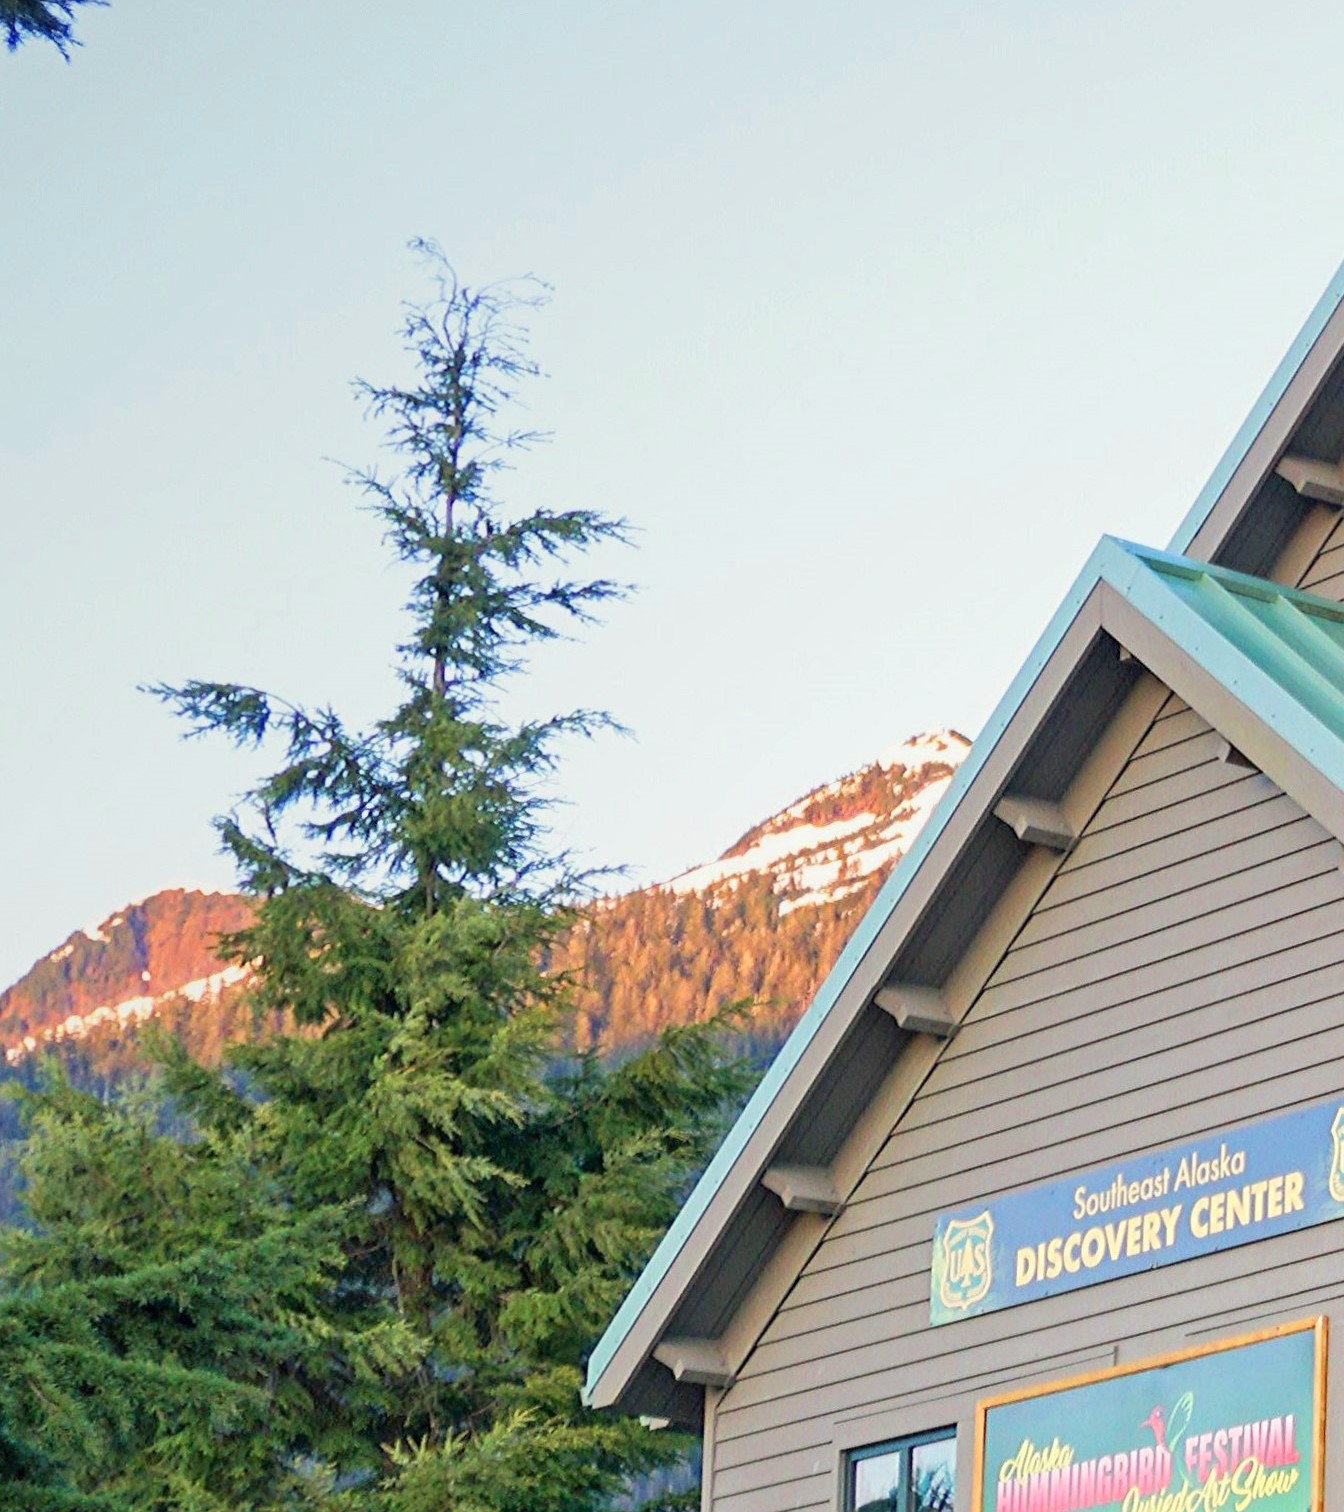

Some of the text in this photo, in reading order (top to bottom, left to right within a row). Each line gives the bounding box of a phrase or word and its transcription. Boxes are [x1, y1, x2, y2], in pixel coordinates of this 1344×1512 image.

[1073, 1143, 1245, 1220] Southeast Alaska
[1015, 1204, 1182, 1287] DISCOVERY
[1190, 1171, 1304, 1238] CENTER
[999, 1437, 1074, 1485] Alaska
[1184, 1414, 1300, 1483] FESTIVAL
[1230, 1456, 1299, 1512] Show
